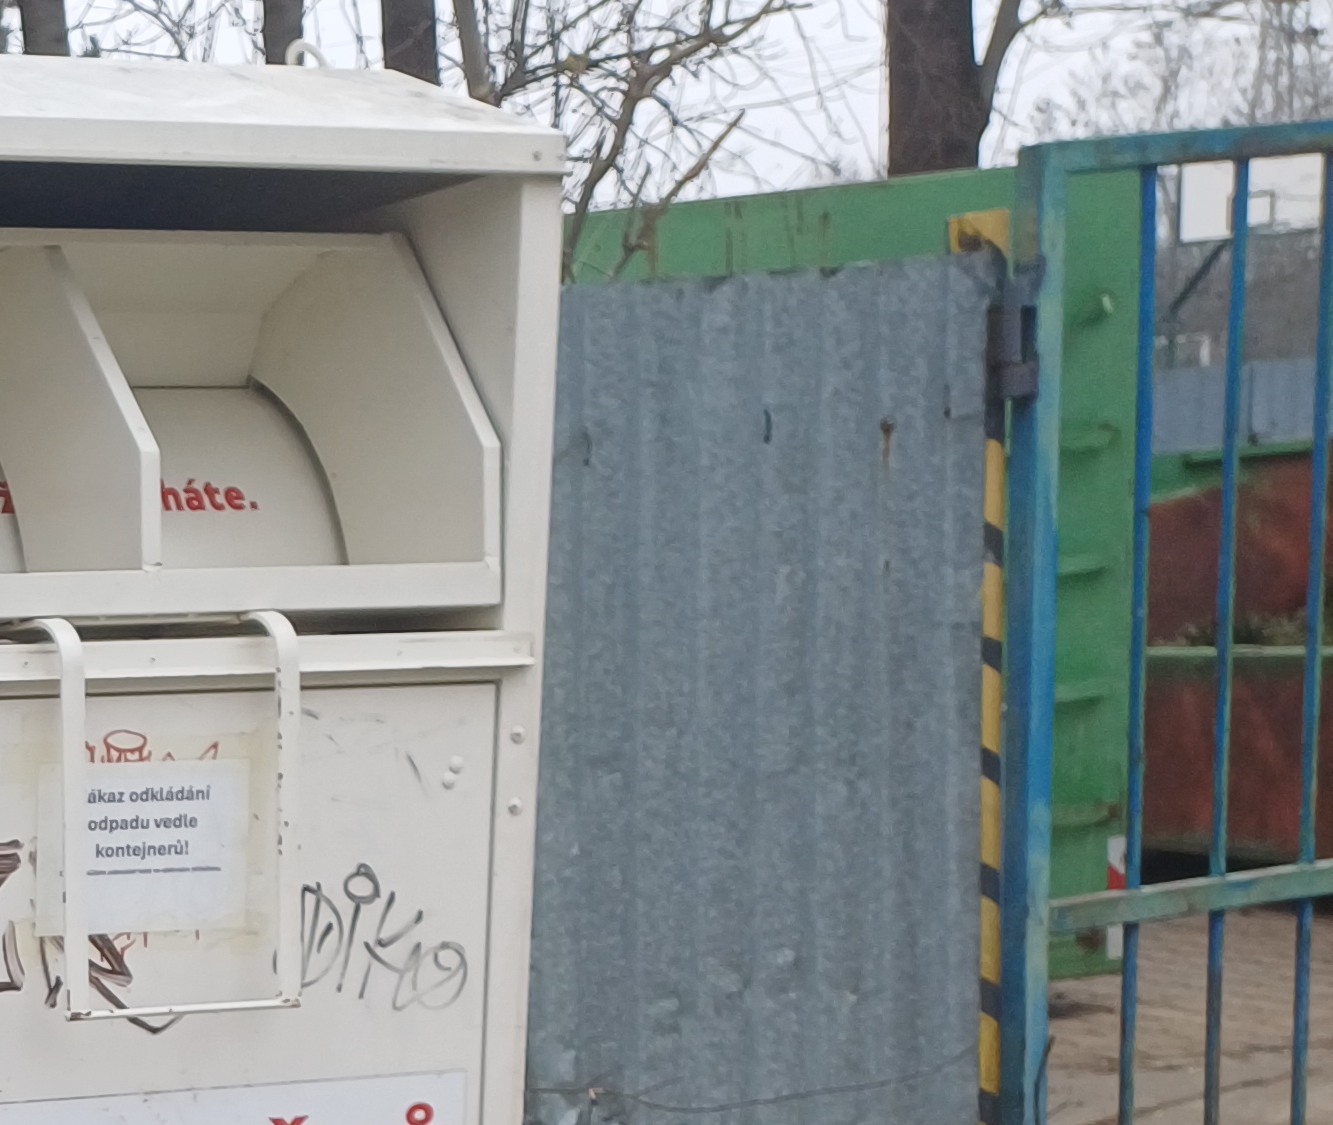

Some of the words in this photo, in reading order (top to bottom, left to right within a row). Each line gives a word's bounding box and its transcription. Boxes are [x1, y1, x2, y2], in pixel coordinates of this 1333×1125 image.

[160, 478, 259, 511] háte.
[87, 787, 125, 804] ákaz
[129, 784, 210, 803] odkládání
[88, 815, 150, 833] odpadu
[154, 813, 198, 829] vedle
[95, 839, 189, 860] kontejnerů!
